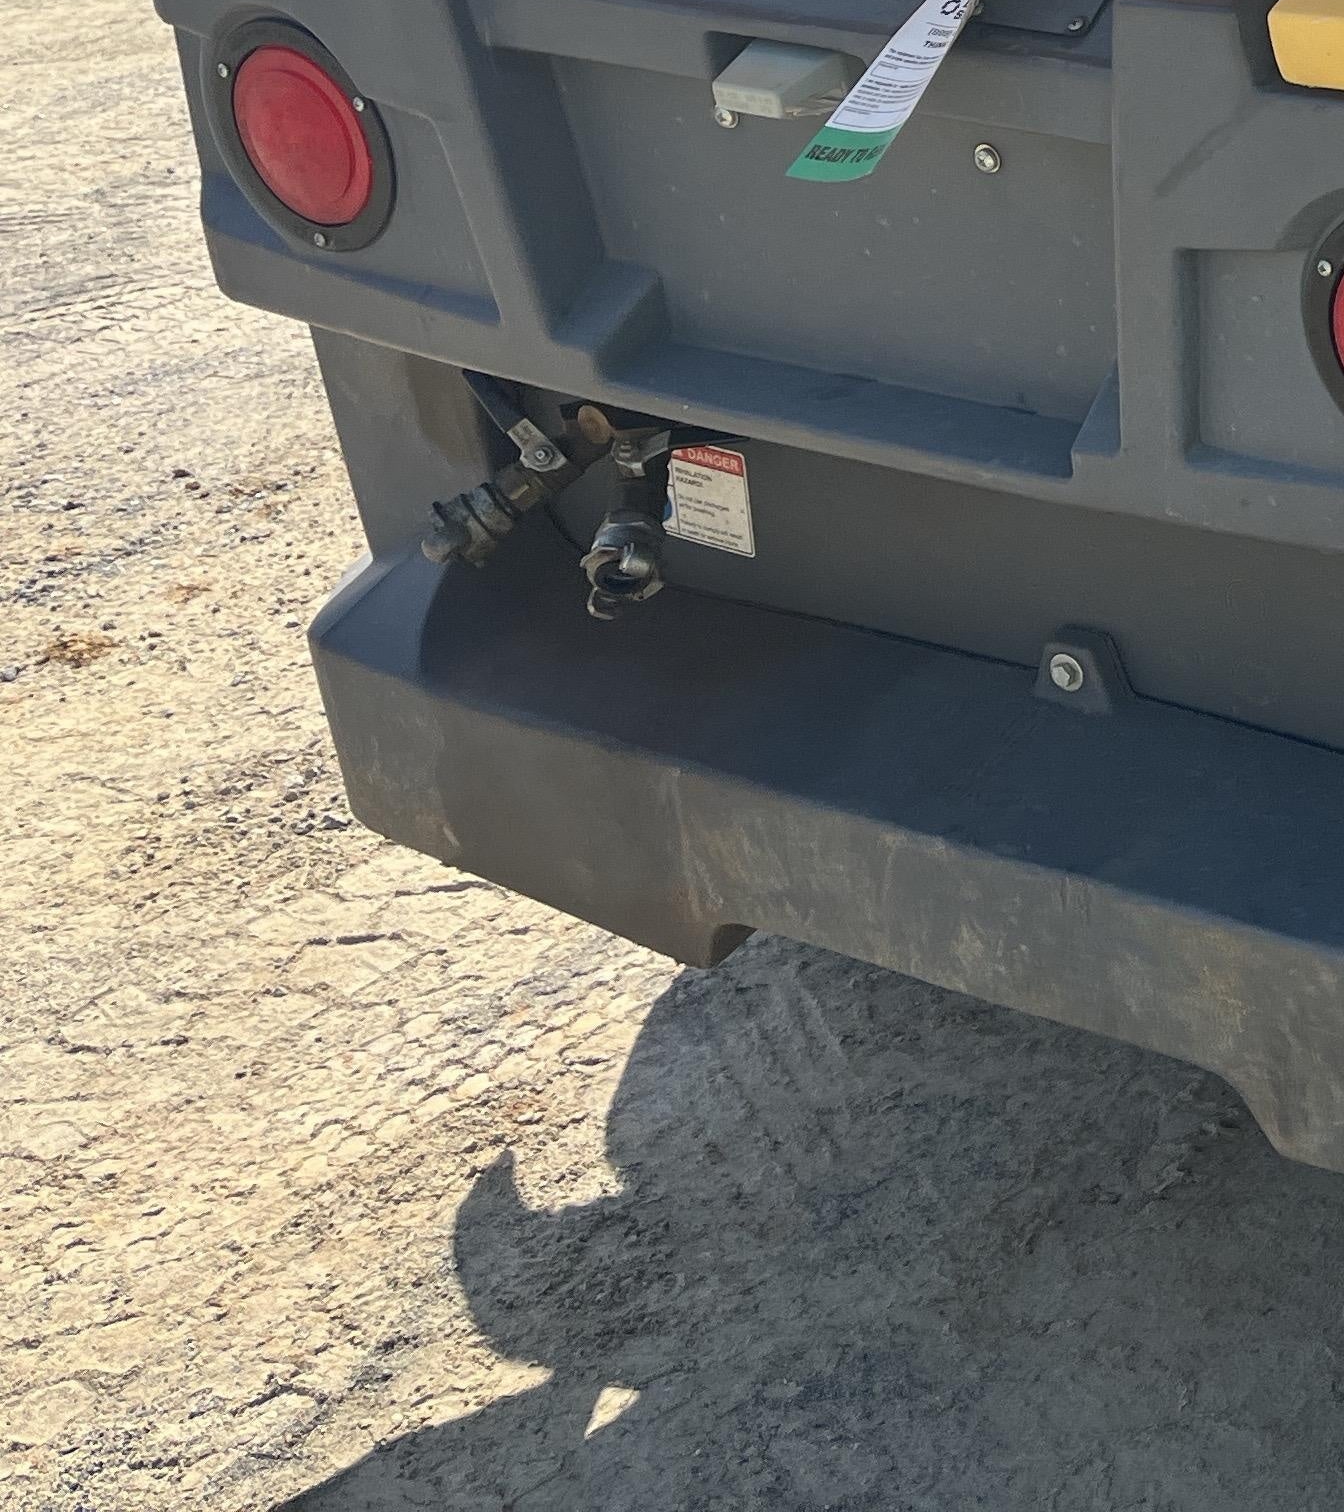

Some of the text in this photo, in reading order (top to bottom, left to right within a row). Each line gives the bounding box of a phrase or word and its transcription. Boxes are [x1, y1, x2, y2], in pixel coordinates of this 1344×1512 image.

[804, 144, 855, 164] READY
[850, 147, 870, 164] TO
[688, 448, 740, 471] DANGER
